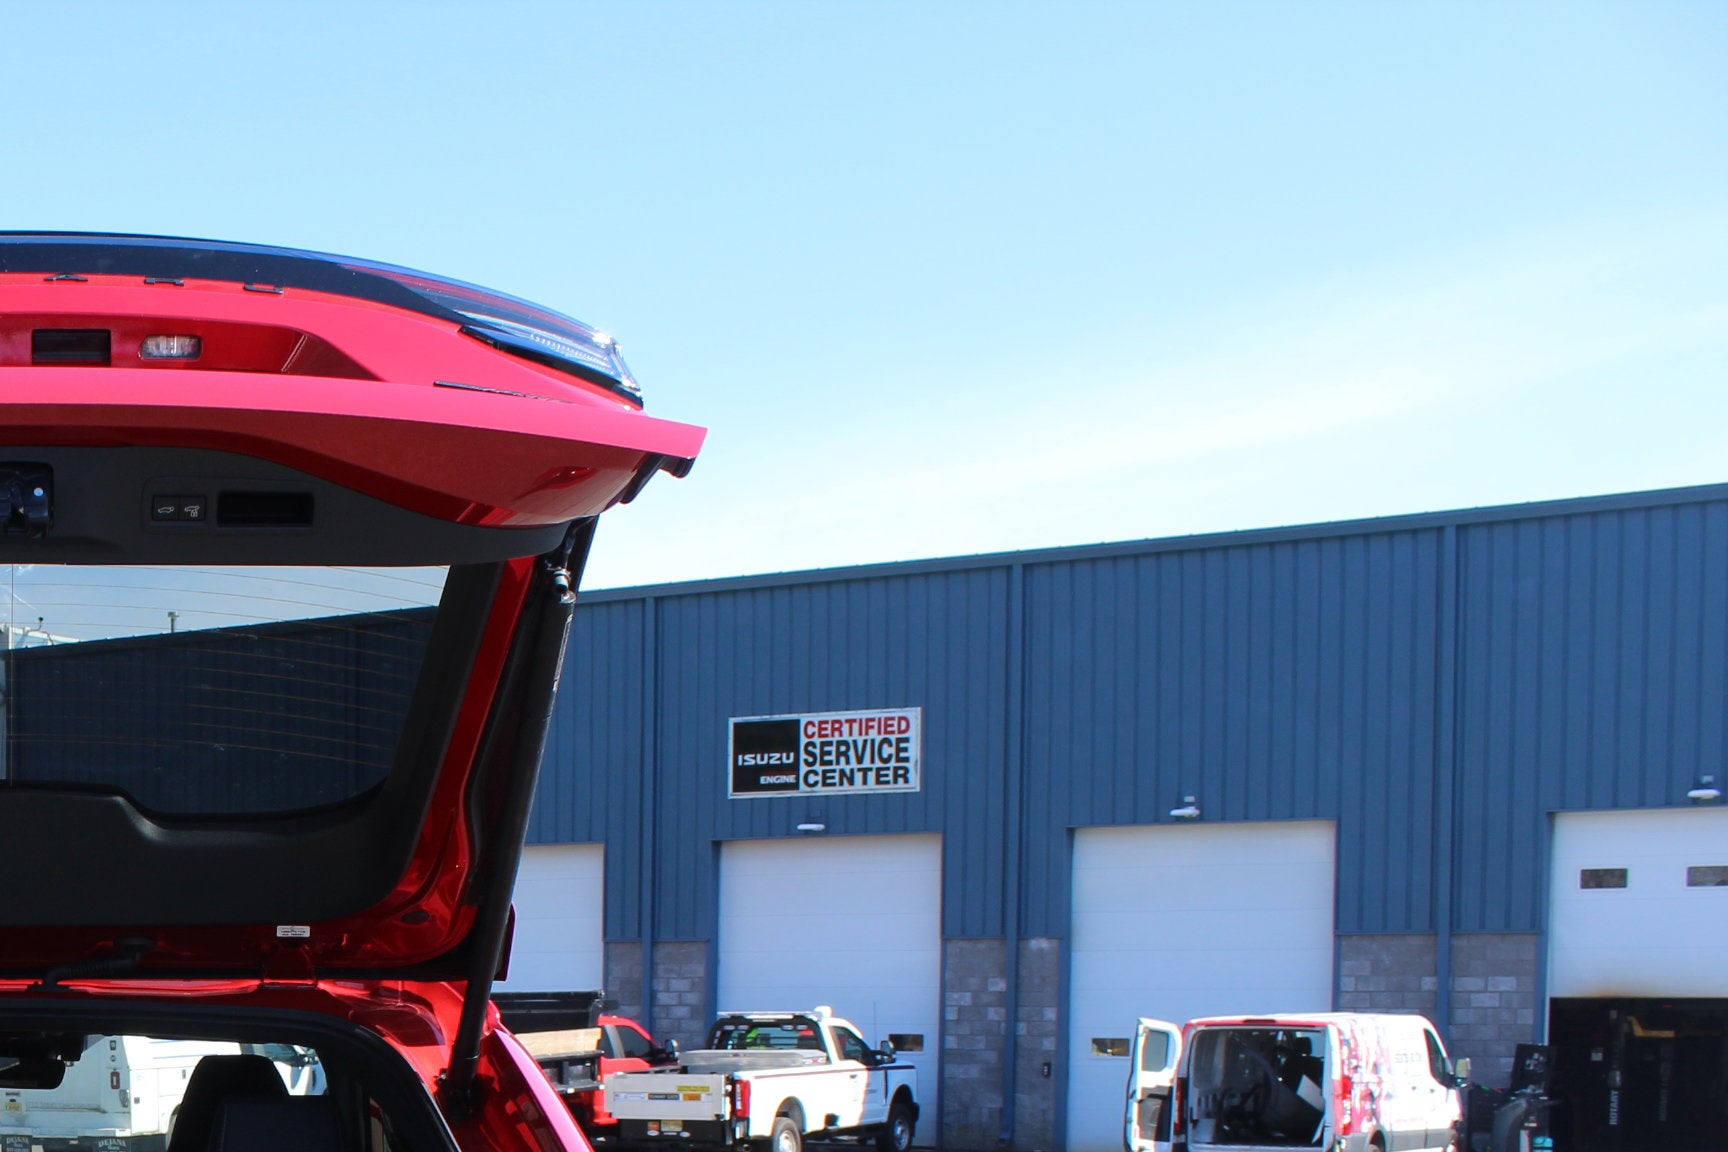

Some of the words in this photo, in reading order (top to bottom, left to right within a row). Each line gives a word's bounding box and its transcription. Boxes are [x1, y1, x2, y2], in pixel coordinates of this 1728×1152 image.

[803, 716, 911, 739] CERTIFIED
[737, 752, 795, 766] ISUZU
[803, 737, 911, 767] SERVICE
[759, 774, 797, 785] ENGINE
[802, 766, 910, 788] CENTER
